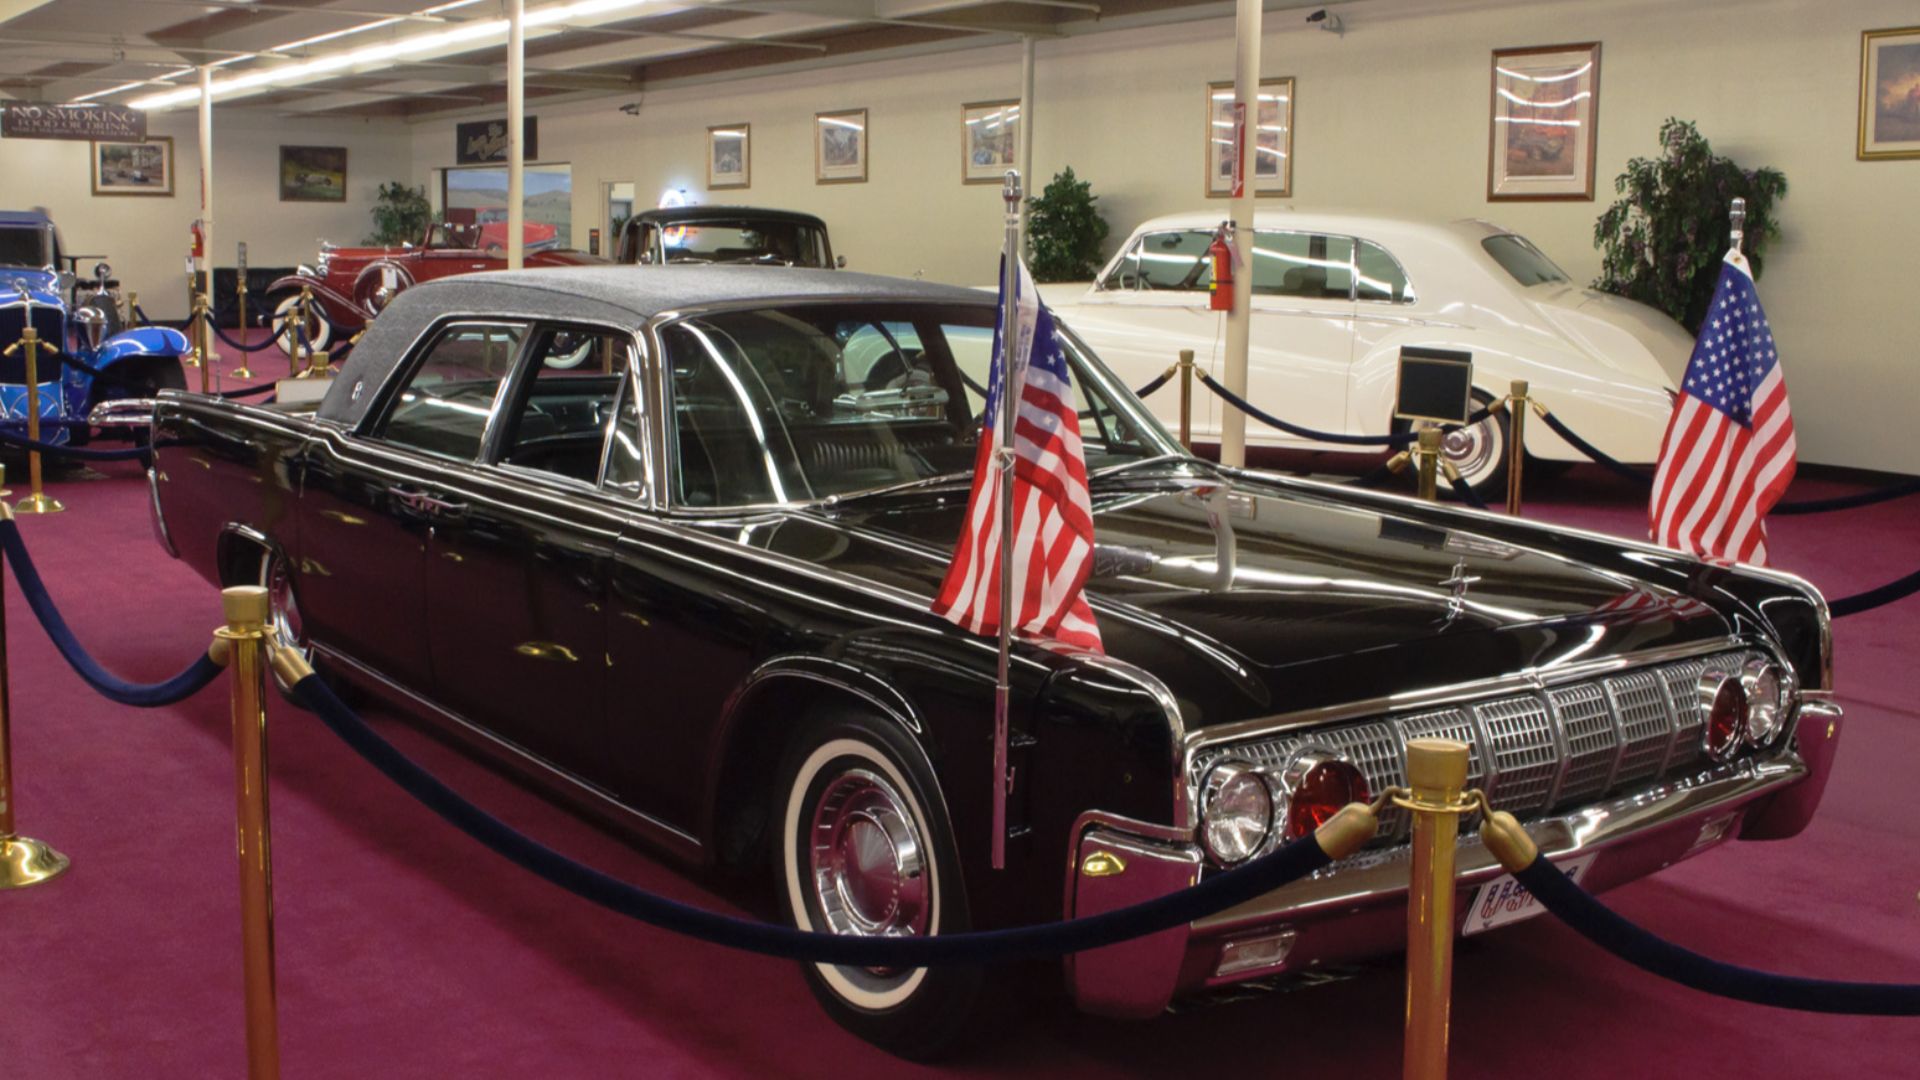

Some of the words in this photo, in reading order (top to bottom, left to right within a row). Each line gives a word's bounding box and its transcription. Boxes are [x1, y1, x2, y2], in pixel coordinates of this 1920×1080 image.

[12, 106, 42, 118] NO
[47, 108, 136, 122] SMOKING
[18, 119, 58, 128] FOOD
[62, 120, 81, 129] OR
[86, 121, 130, 131] DRINK
